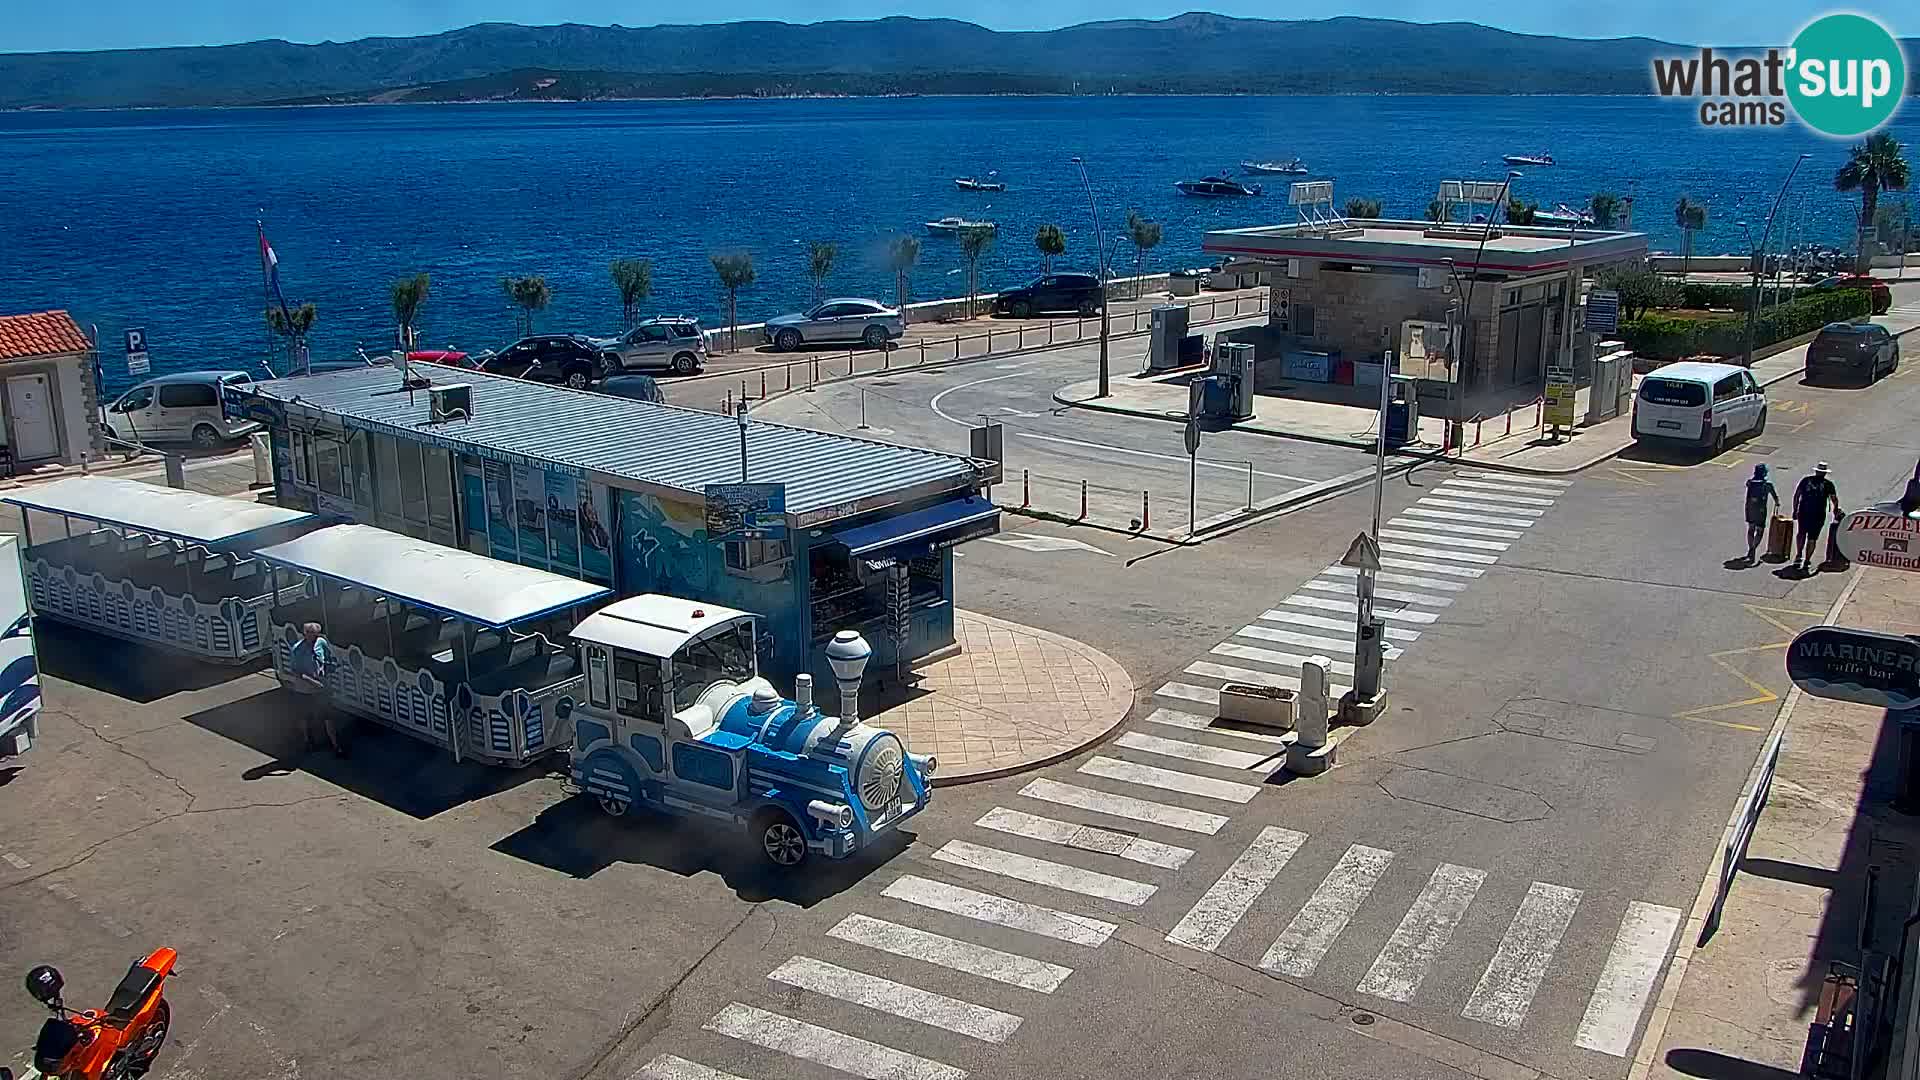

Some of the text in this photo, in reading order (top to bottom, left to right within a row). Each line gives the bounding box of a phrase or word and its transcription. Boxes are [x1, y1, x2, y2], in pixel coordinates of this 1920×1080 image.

[129, 331, 141, 350] P
[478, 446, 492, 458] BUS
[493, 449, 525, 465] STATION
[527, 457, 553, 473] TICKET
[554, 464, 580, 477] OFFICE
[1847, 515, 1920, 533] PIZZE
[1869, 665, 1895, 679] bar
